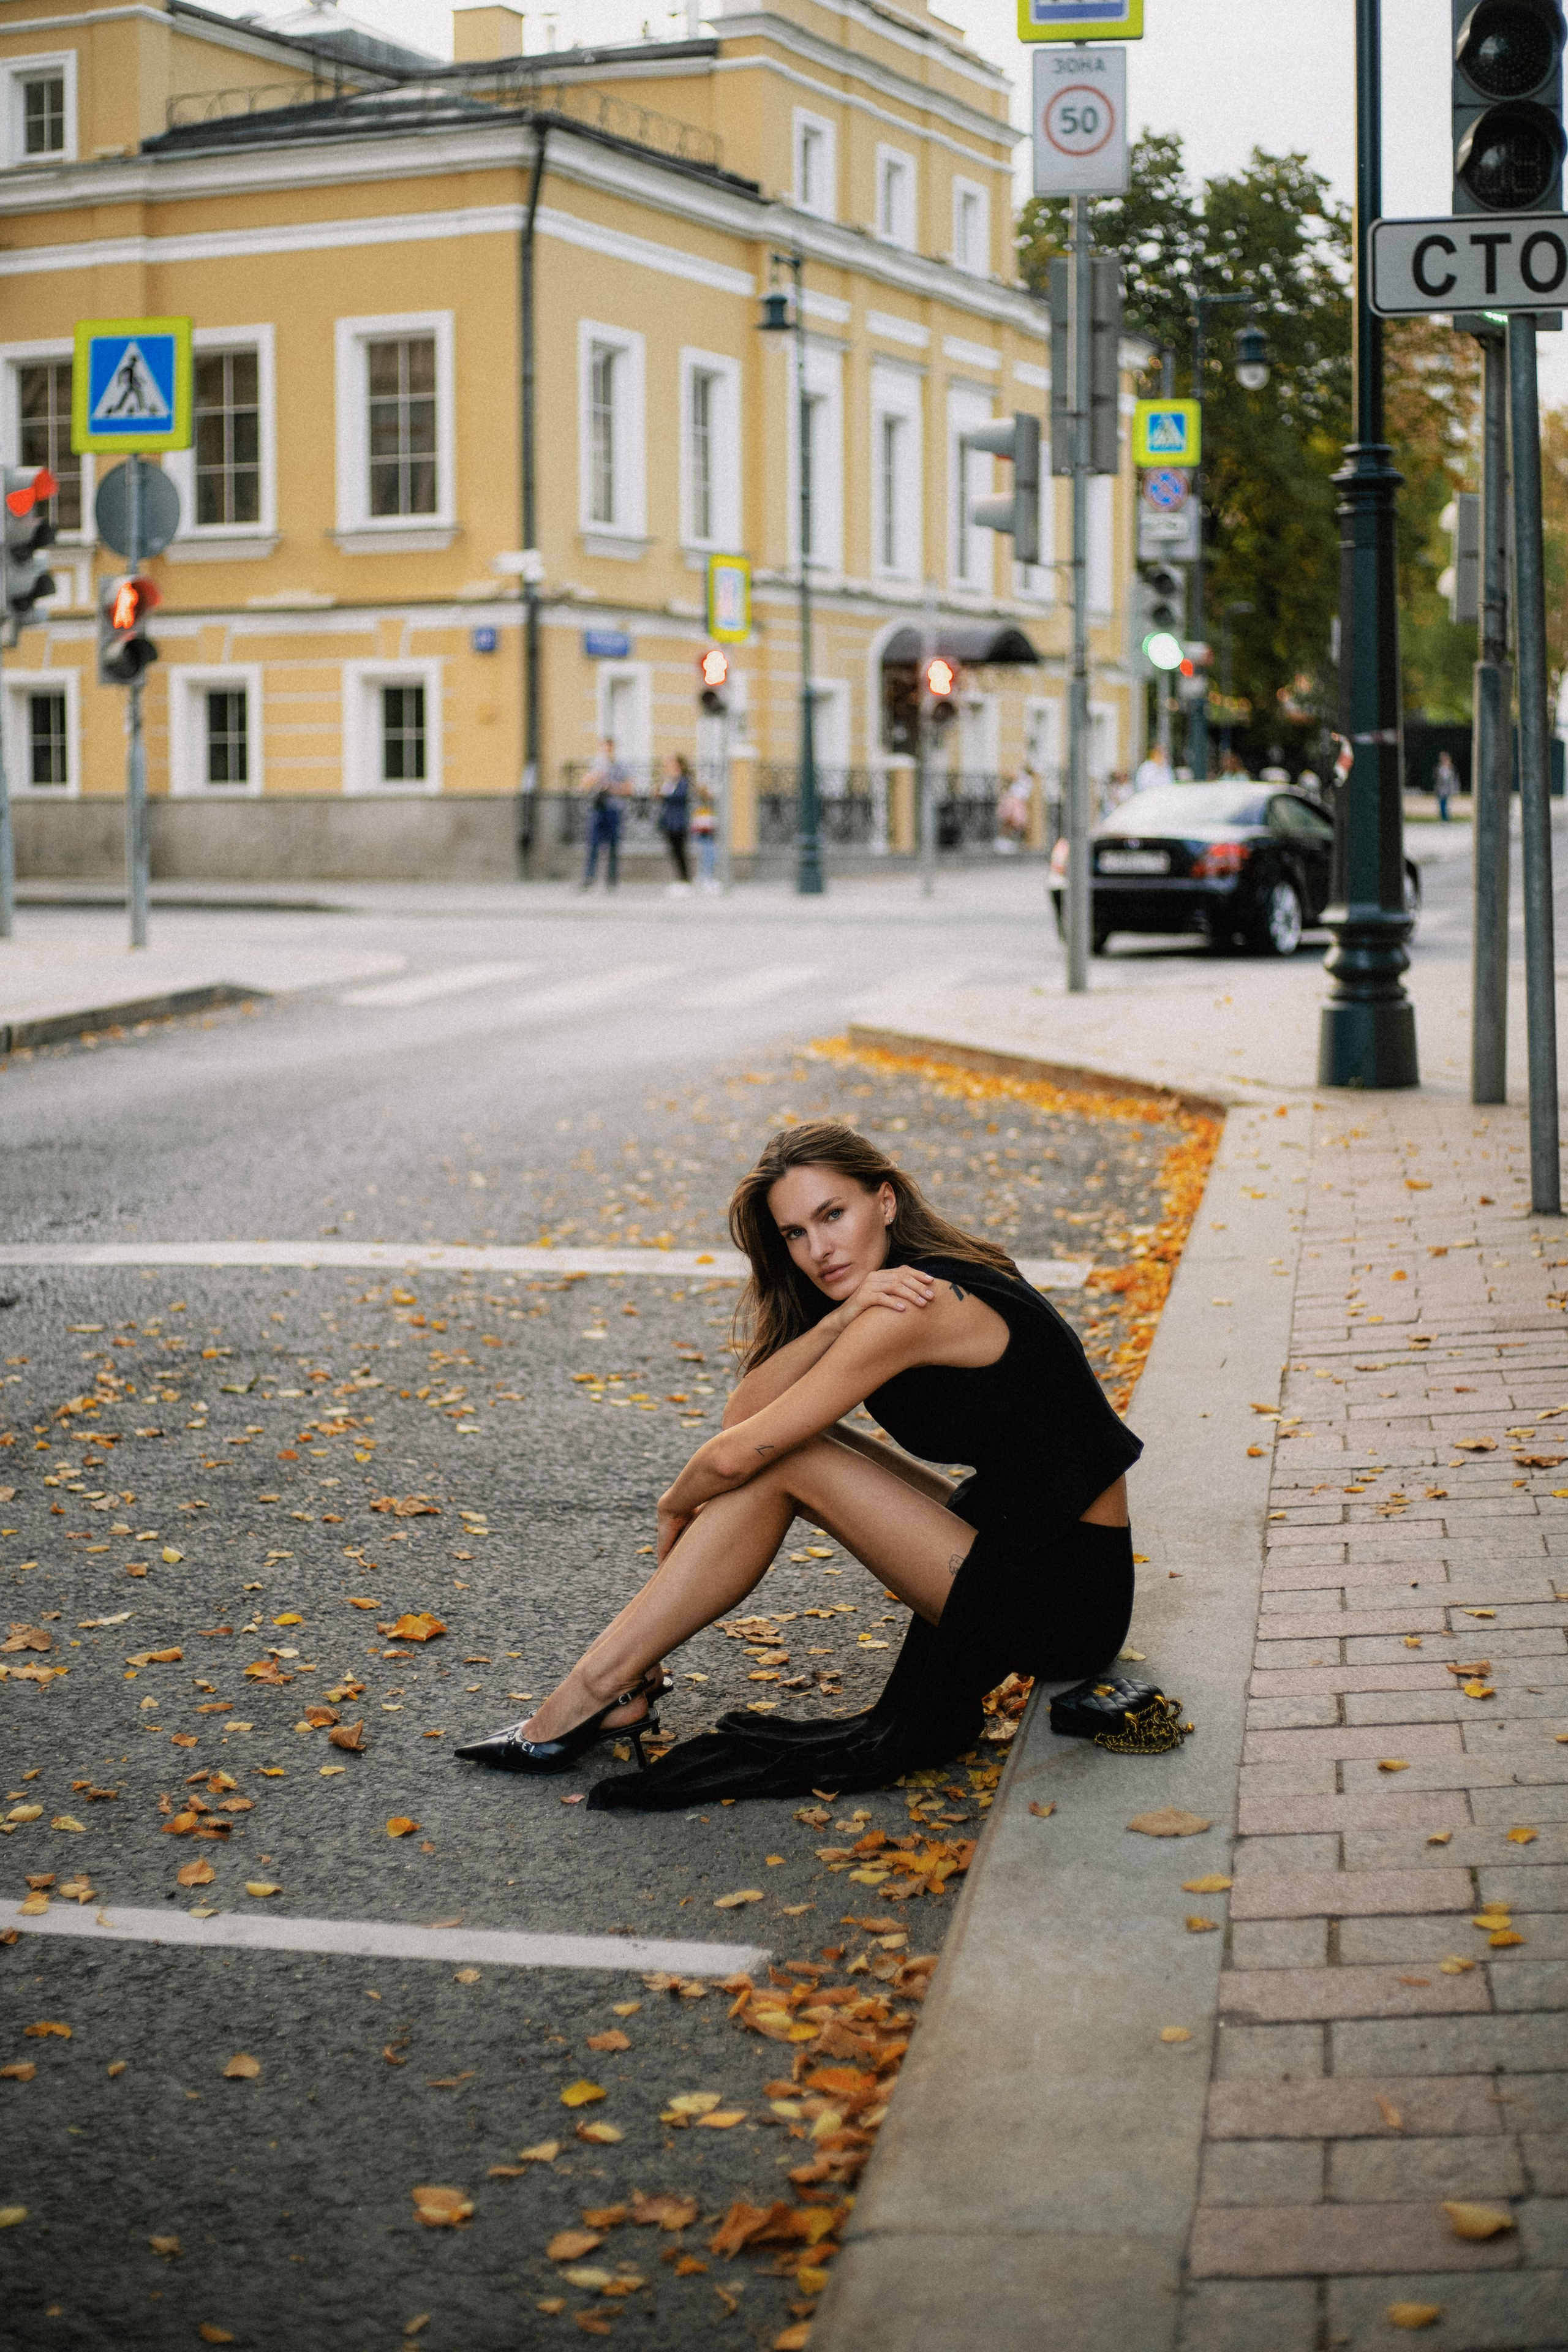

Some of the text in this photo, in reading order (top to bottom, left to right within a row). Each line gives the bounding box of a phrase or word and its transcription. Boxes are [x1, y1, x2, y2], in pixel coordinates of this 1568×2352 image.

[1054, 58, 1106, 74] ЗОНА
[1061, 106, 1098, 134] 50
[1412, 230, 1567, 297] СТО
